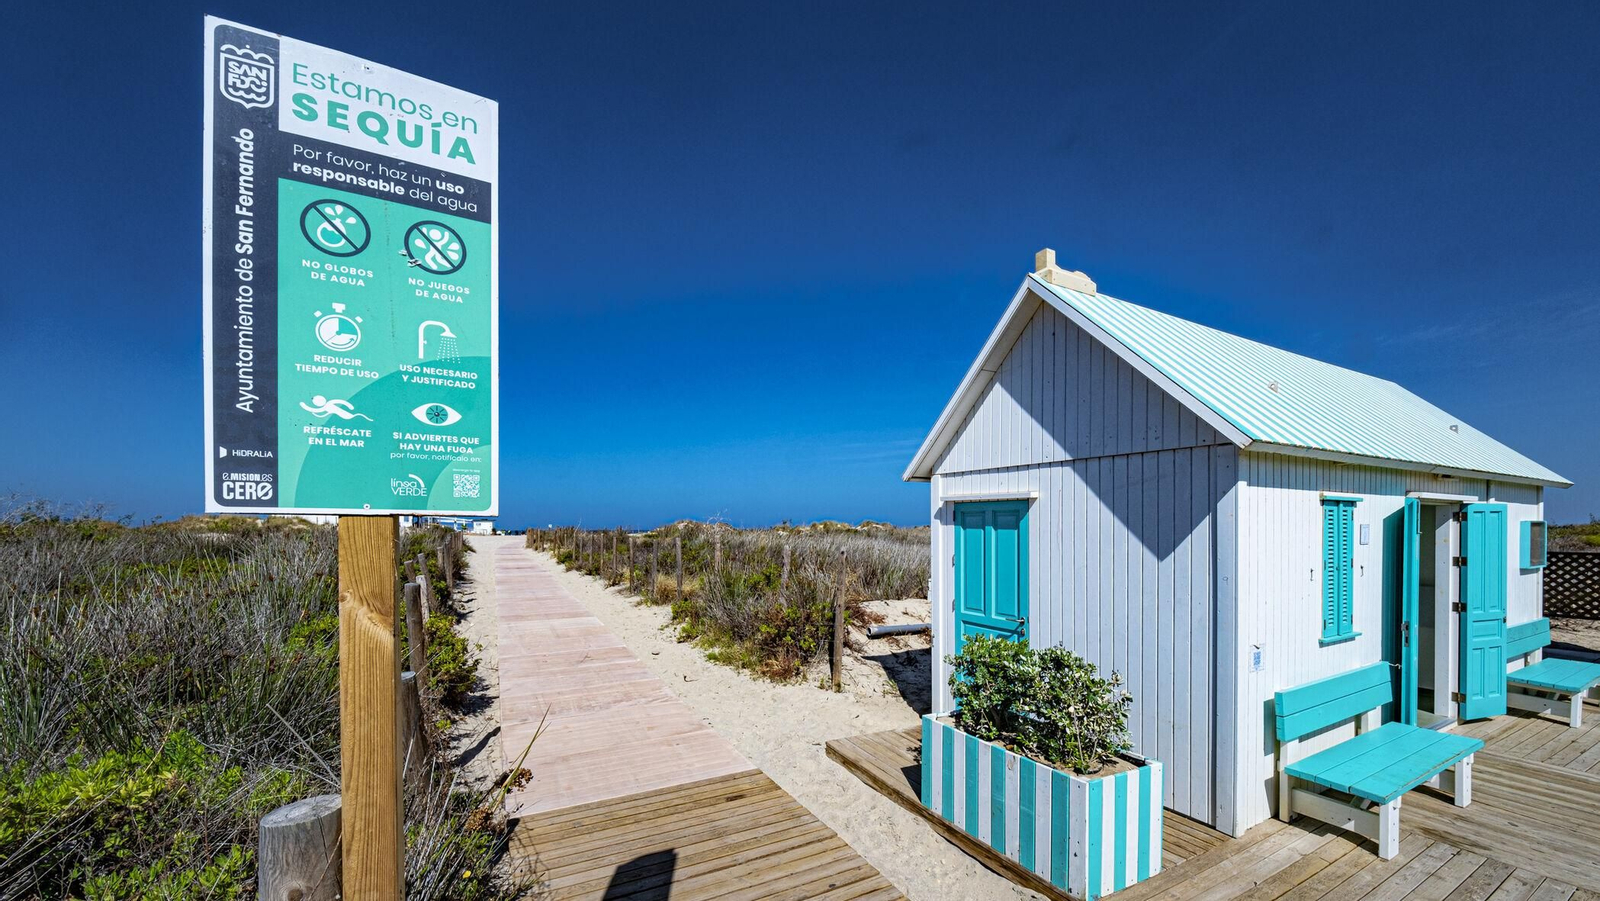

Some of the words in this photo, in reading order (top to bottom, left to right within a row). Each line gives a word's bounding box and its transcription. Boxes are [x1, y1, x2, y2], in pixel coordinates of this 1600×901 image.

[293, 62, 433, 120] Estamos
[442, 109, 478, 135] en
[291, 92, 477, 165] SEQUÍA
[231, 128, 254, 217] Fernando
[293, 143, 322, 161] Por
[327, 150, 375, 174] favor,
[378, 163, 408, 181] haz
[411, 172, 432, 187] un
[435, 178, 465, 195] uso
[293, 161, 405, 195] responsable
[409, 187, 434, 202] del
[437, 195, 478, 213] agua
[235, 219, 254, 255] San
[234, 258, 254, 281] de
[302, 258, 321, 270] NO
[324, 263, 375, 278] GLOBOS
[310, 271, 328, 281] DE
[330, 274, 366, 287] AGUA
[408, 277, 426, 287] NO
[428, 280, 471, 295] JUEGOS
[415, 288, 430, 298] DE
[431, 291, 464, 304] AGUA
[233, 285, 260, 413] Ayuntamiento
[313, 354, 362, 367] REDUCIR
[295, 363, 339, 376] TIEMPO
[340, 367, 355, 377] DE
[356, 369, 379, 380] USO
[399, 364, 421, 374] USO
[422, 366, 478, 380] NECESARIO
[402, 374, 410, 383] Y
[410, 375, 476, 389] JUSTIFICADO
[303, 425, 372, 438] REFRÉSCATE
[392, 431, 402, 440] SI
[404, 432, 459, 443] ADVIERTES
[460, 436, 480, 445] QUE
[308, 437, 324, 446] EN
[326, 438, 340, 447] EL
[342, 438, 365, 448] MAR
[399, 443, 421, 451] HAY
[423, 444, 446, 452] UNA
[447, 446, 474, 454] FUGA
[390, 452, 405, 460] por
[390, 487, 428, 497] VERDE
